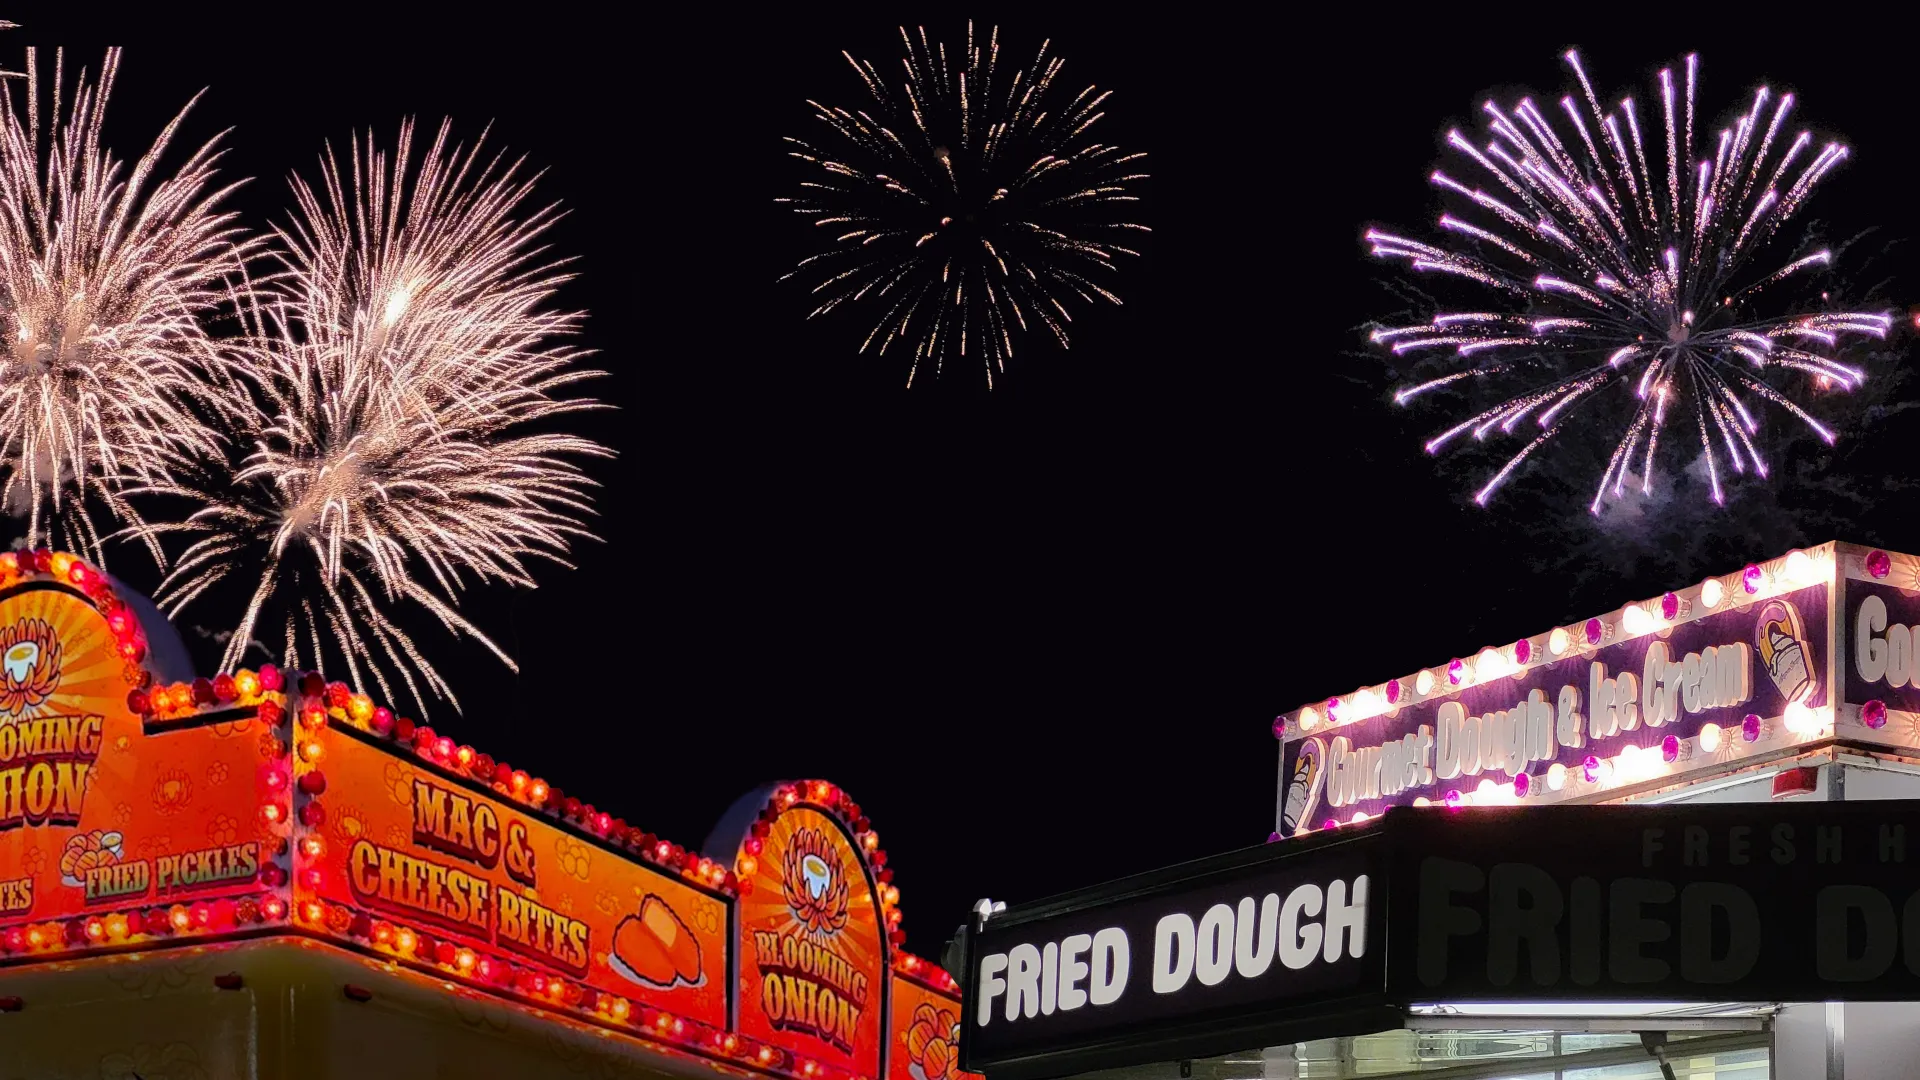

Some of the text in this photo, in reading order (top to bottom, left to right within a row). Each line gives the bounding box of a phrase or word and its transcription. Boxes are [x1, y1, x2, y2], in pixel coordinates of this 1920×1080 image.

[1857, 595, 1920, 689] Go
[1327, 640, 1749, 808] Gourmet Dough & Ice Cream
[0, 762, 89, 820] ION
[414, 781, 534, 879] MAC &
[86, 842, 258, 900] FRIED PICKLES
[1641, 822, 1843, 867] FRESH
[351, 840, 588, 969] CHEESE BITES
[978, 873, 1370, 1028] FRIED DOUGH
[1416, 855, 1920, 988] FRIED D
[755, 931, 868, 1006] BLOOMING
[763, 972, 861, 1045] ONION
